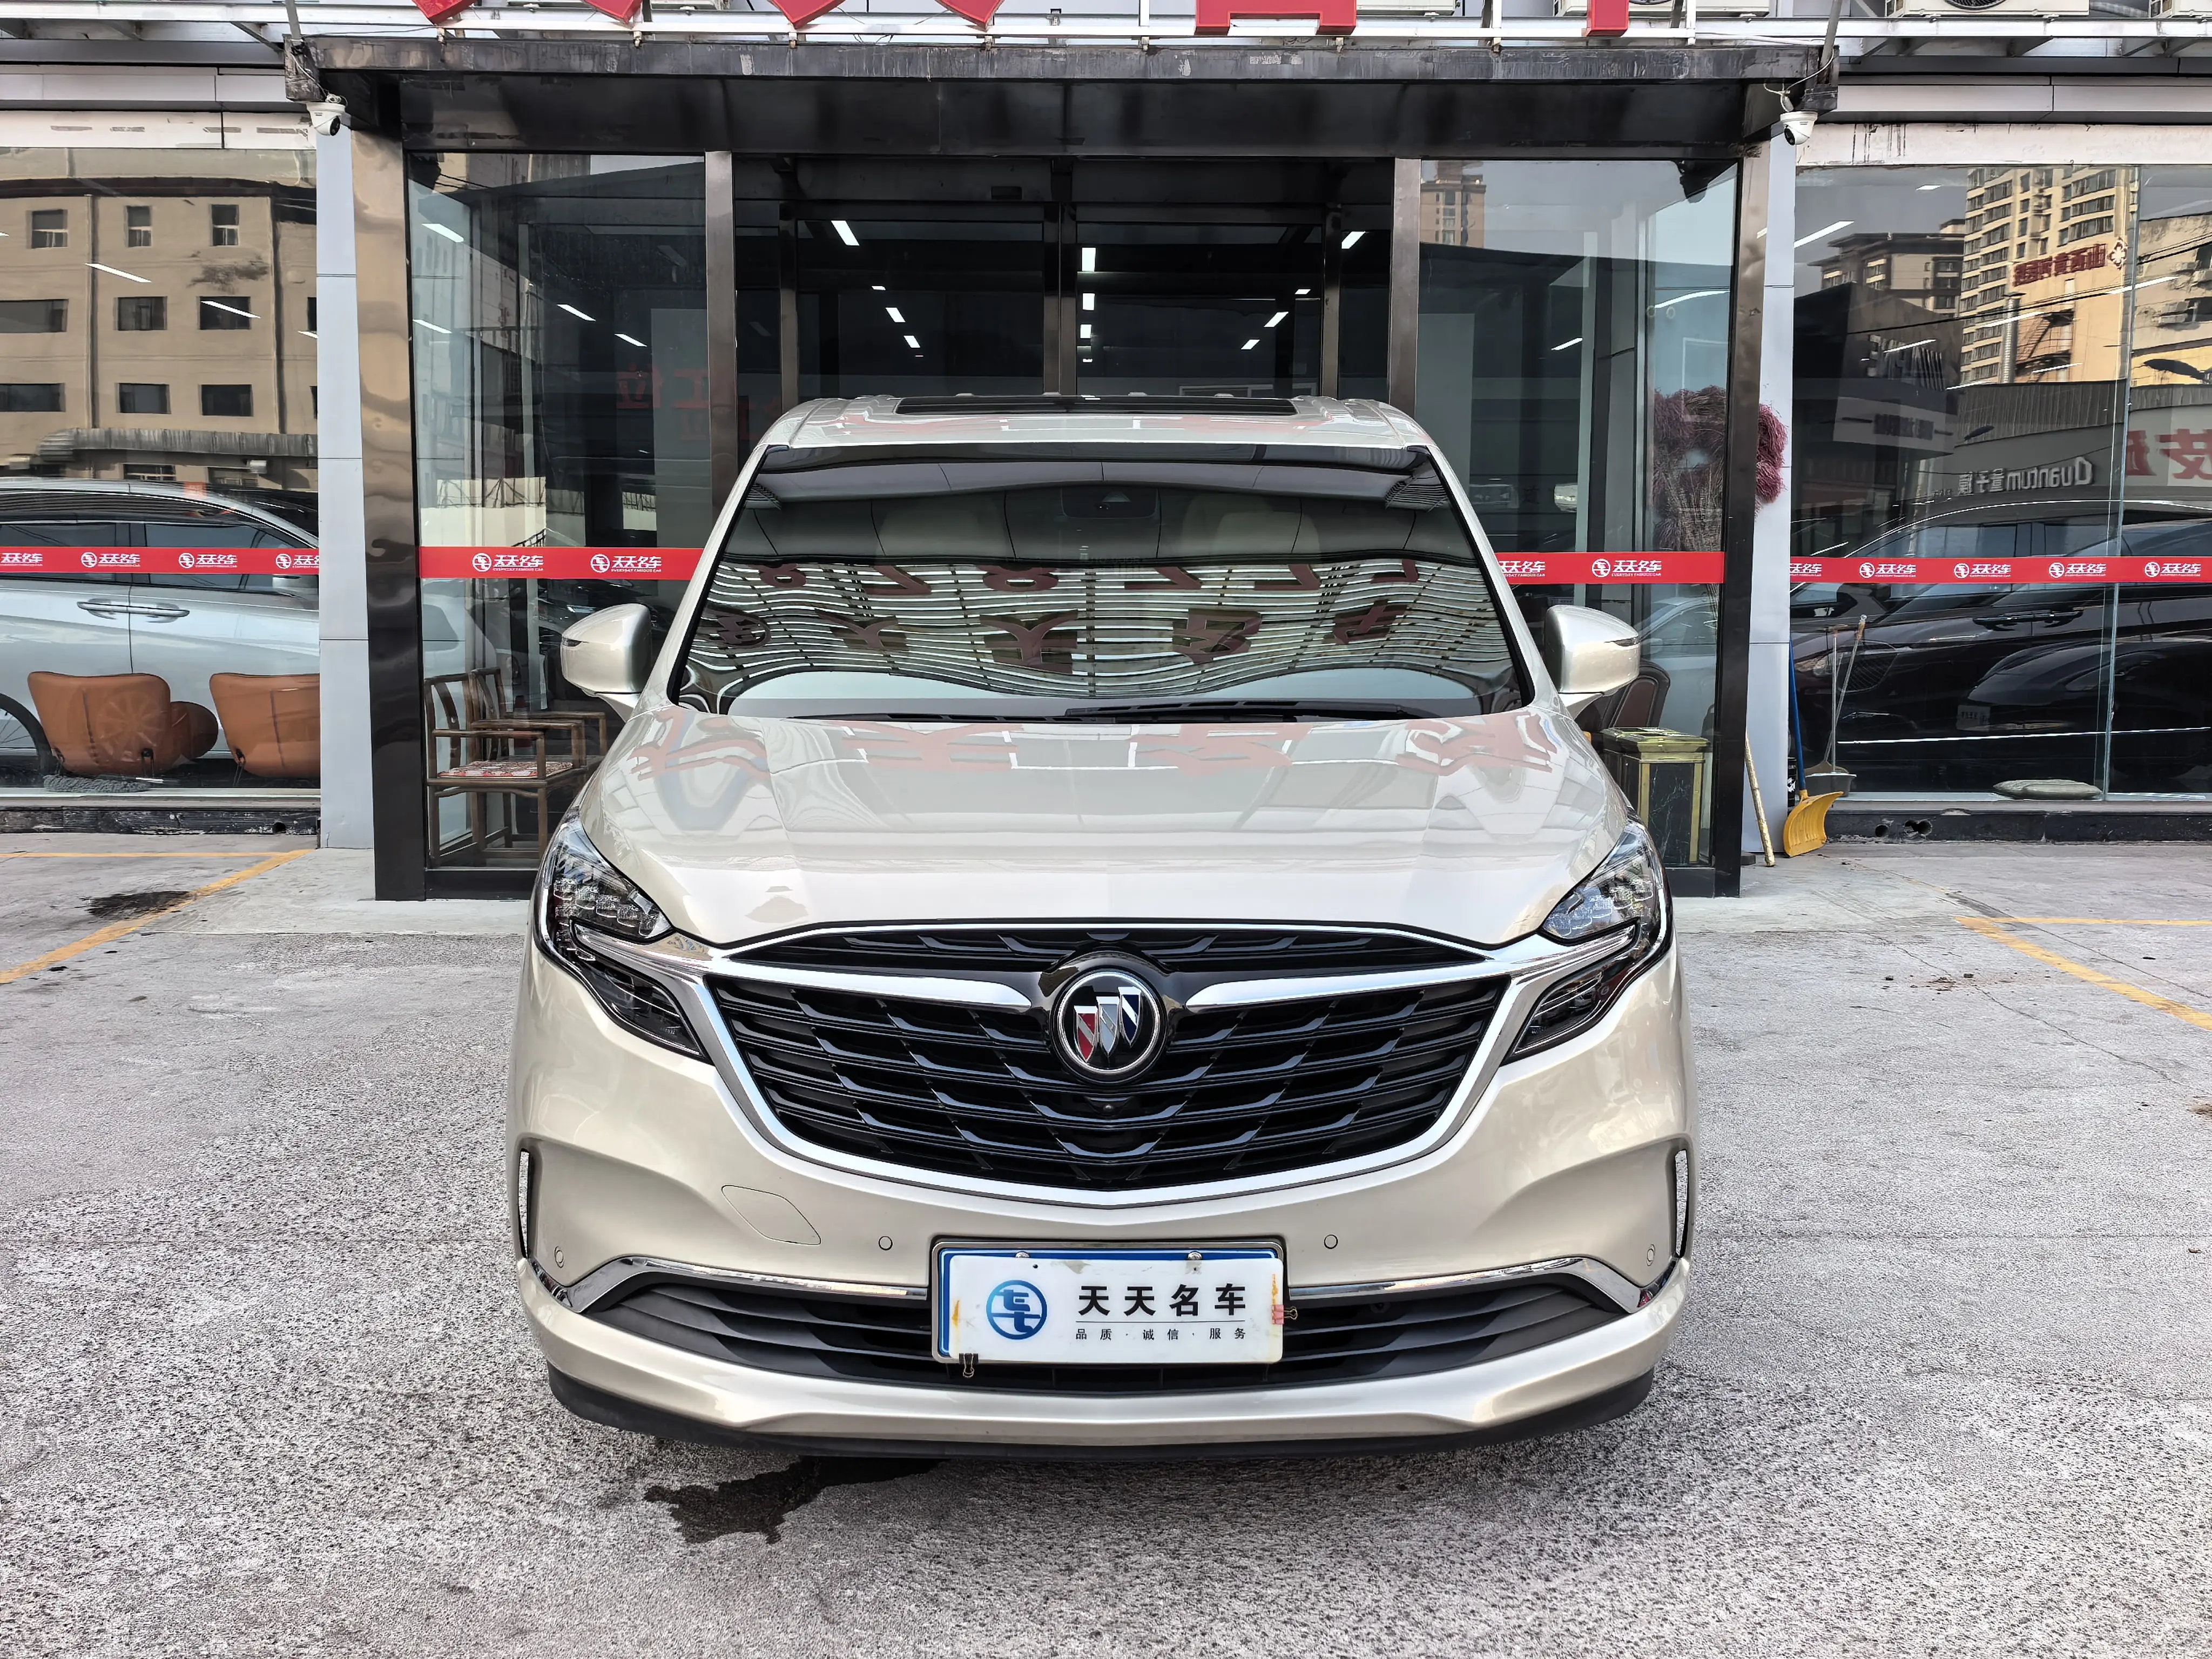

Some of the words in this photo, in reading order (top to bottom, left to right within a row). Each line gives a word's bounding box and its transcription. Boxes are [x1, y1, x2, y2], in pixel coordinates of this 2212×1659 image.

[195, 554, 238, 564] 天天名车
[493, 555, 544, 568] 天天名车
[611, 556, 662, 569] 天天名车
[1612, 560, 1662, 572] 天天名车
[1877, 564, 1916, 574] 天天名车
[1971, 564, 2011, 574] 天天名车
[2160, 563, 2201, 574] 天天名车
[1078, 1283, 1246, 1317] 天天名车
